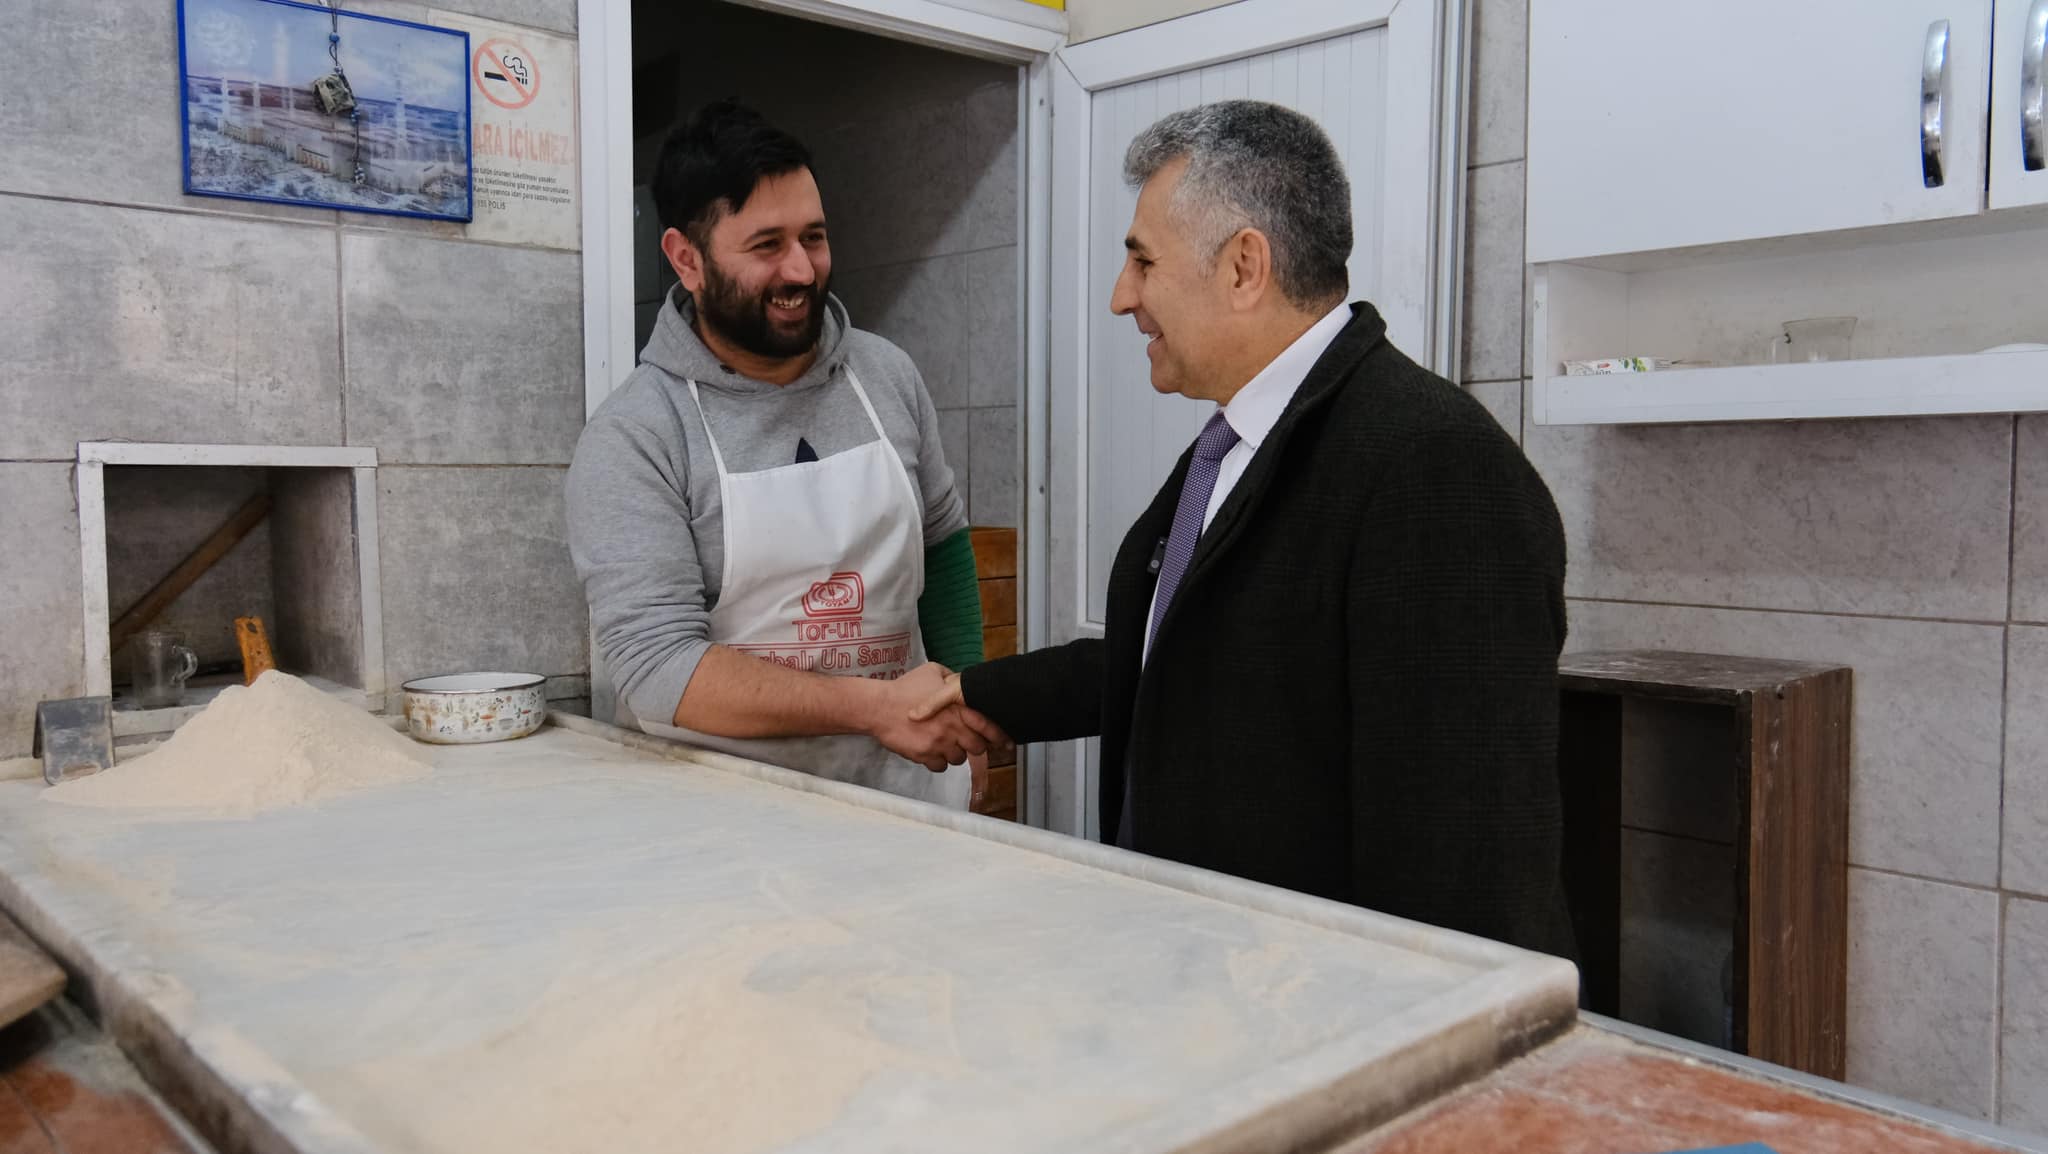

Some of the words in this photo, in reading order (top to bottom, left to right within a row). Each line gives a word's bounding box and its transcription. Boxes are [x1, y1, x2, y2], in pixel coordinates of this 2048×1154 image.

[508, 120, 570, 165] İÇİLMEZ
[792, 617, 863, 641] Tor-un
[820, 648, 850, 670] Un
